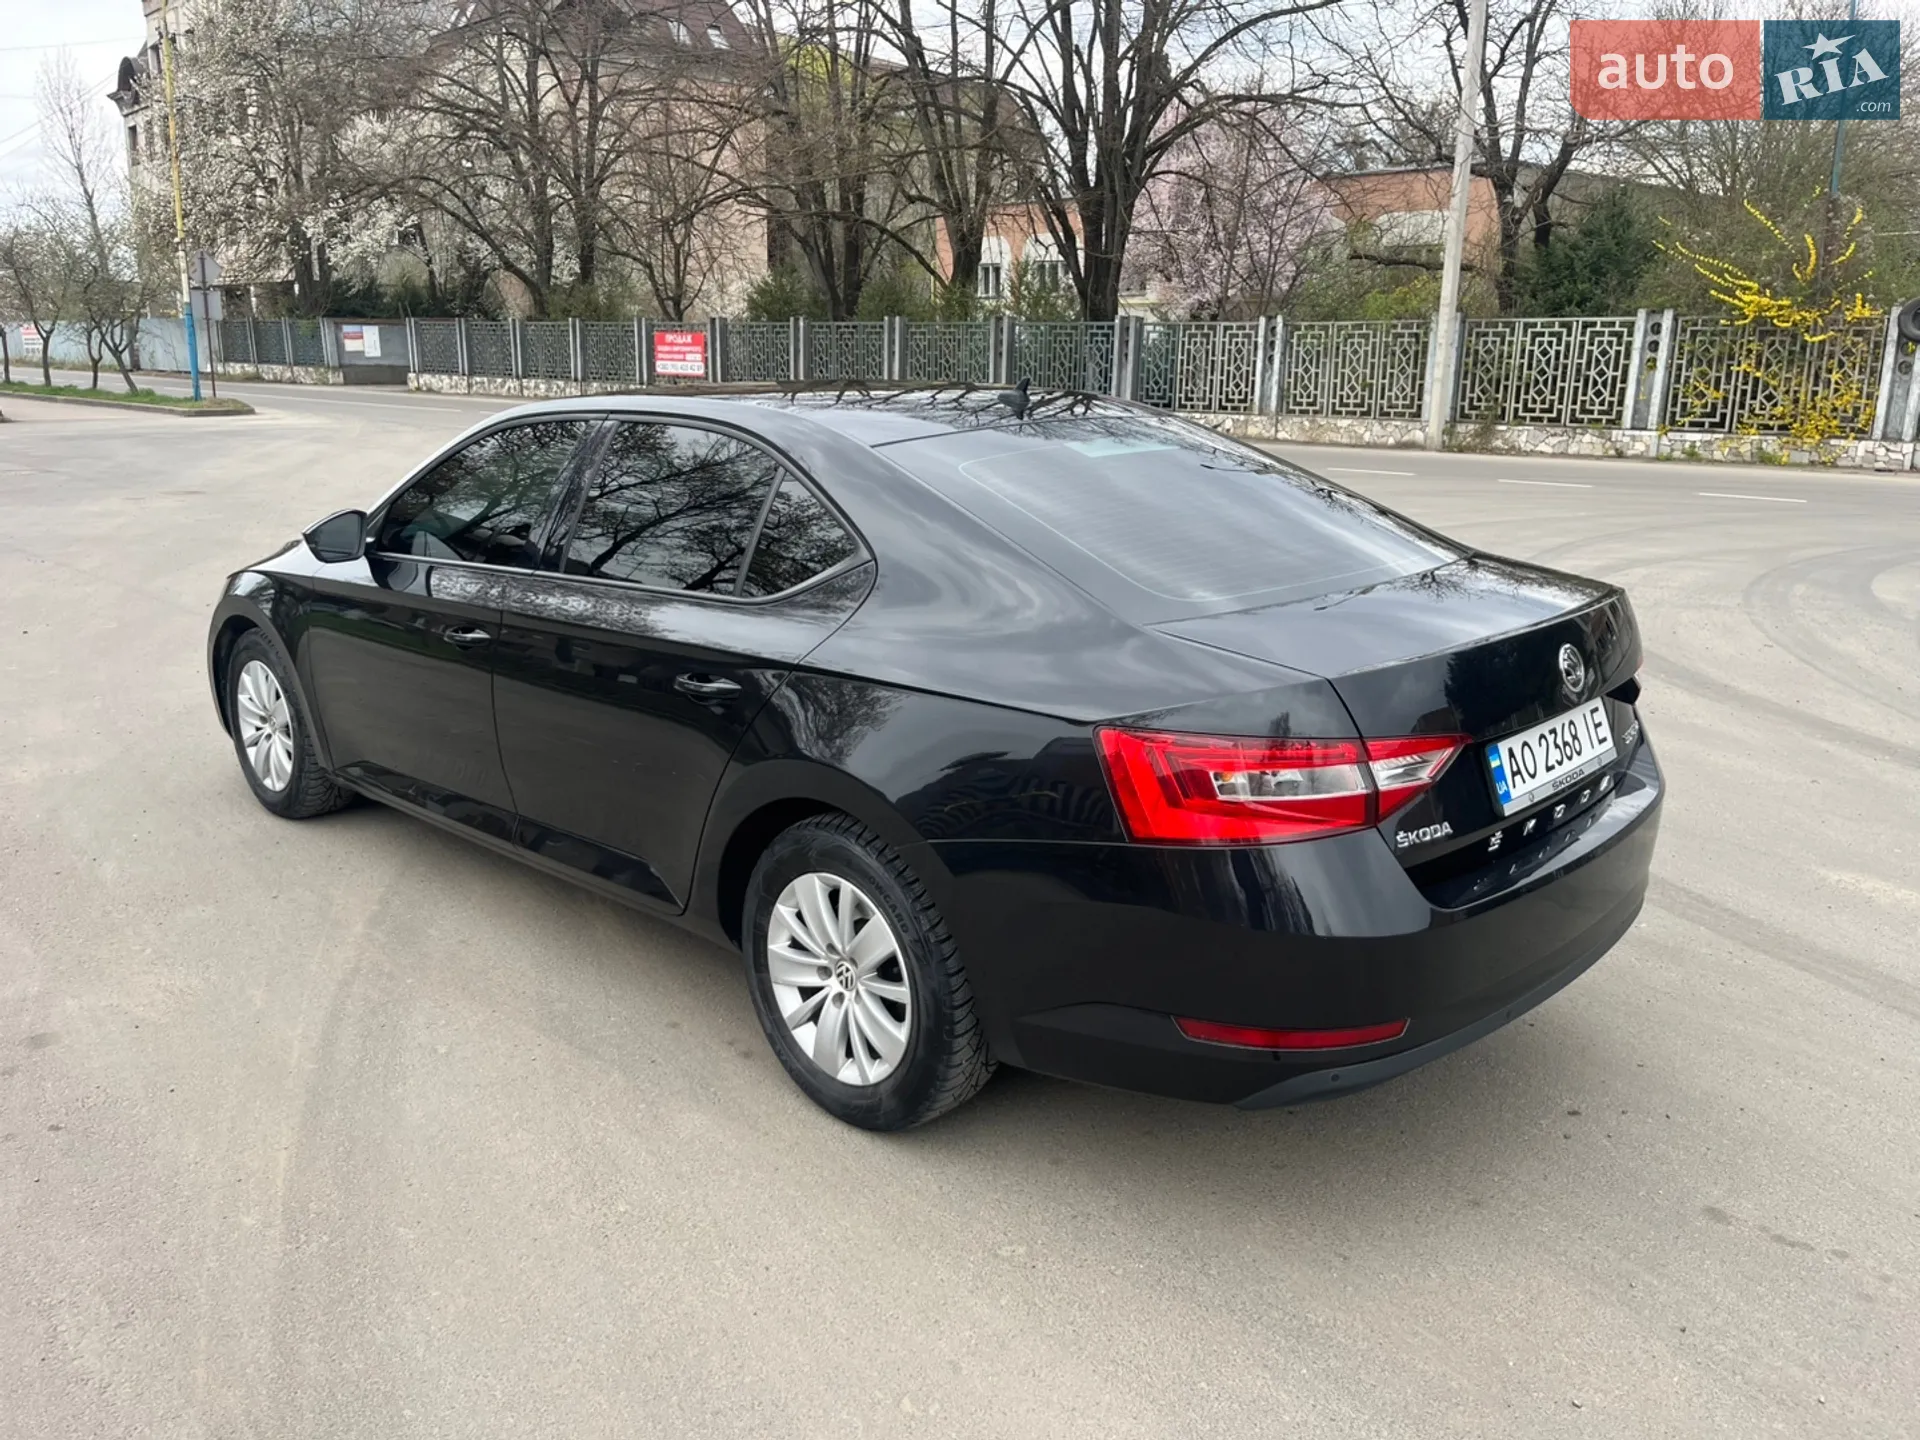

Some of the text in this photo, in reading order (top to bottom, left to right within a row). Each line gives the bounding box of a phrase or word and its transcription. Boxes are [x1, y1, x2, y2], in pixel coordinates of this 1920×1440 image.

[1507, 740, 1538, 789] AO
[1539, 719, 1583, 774] 2368
[1583, 706, 1607, 750] IE
[1497, 779, 1508, 795] UA
